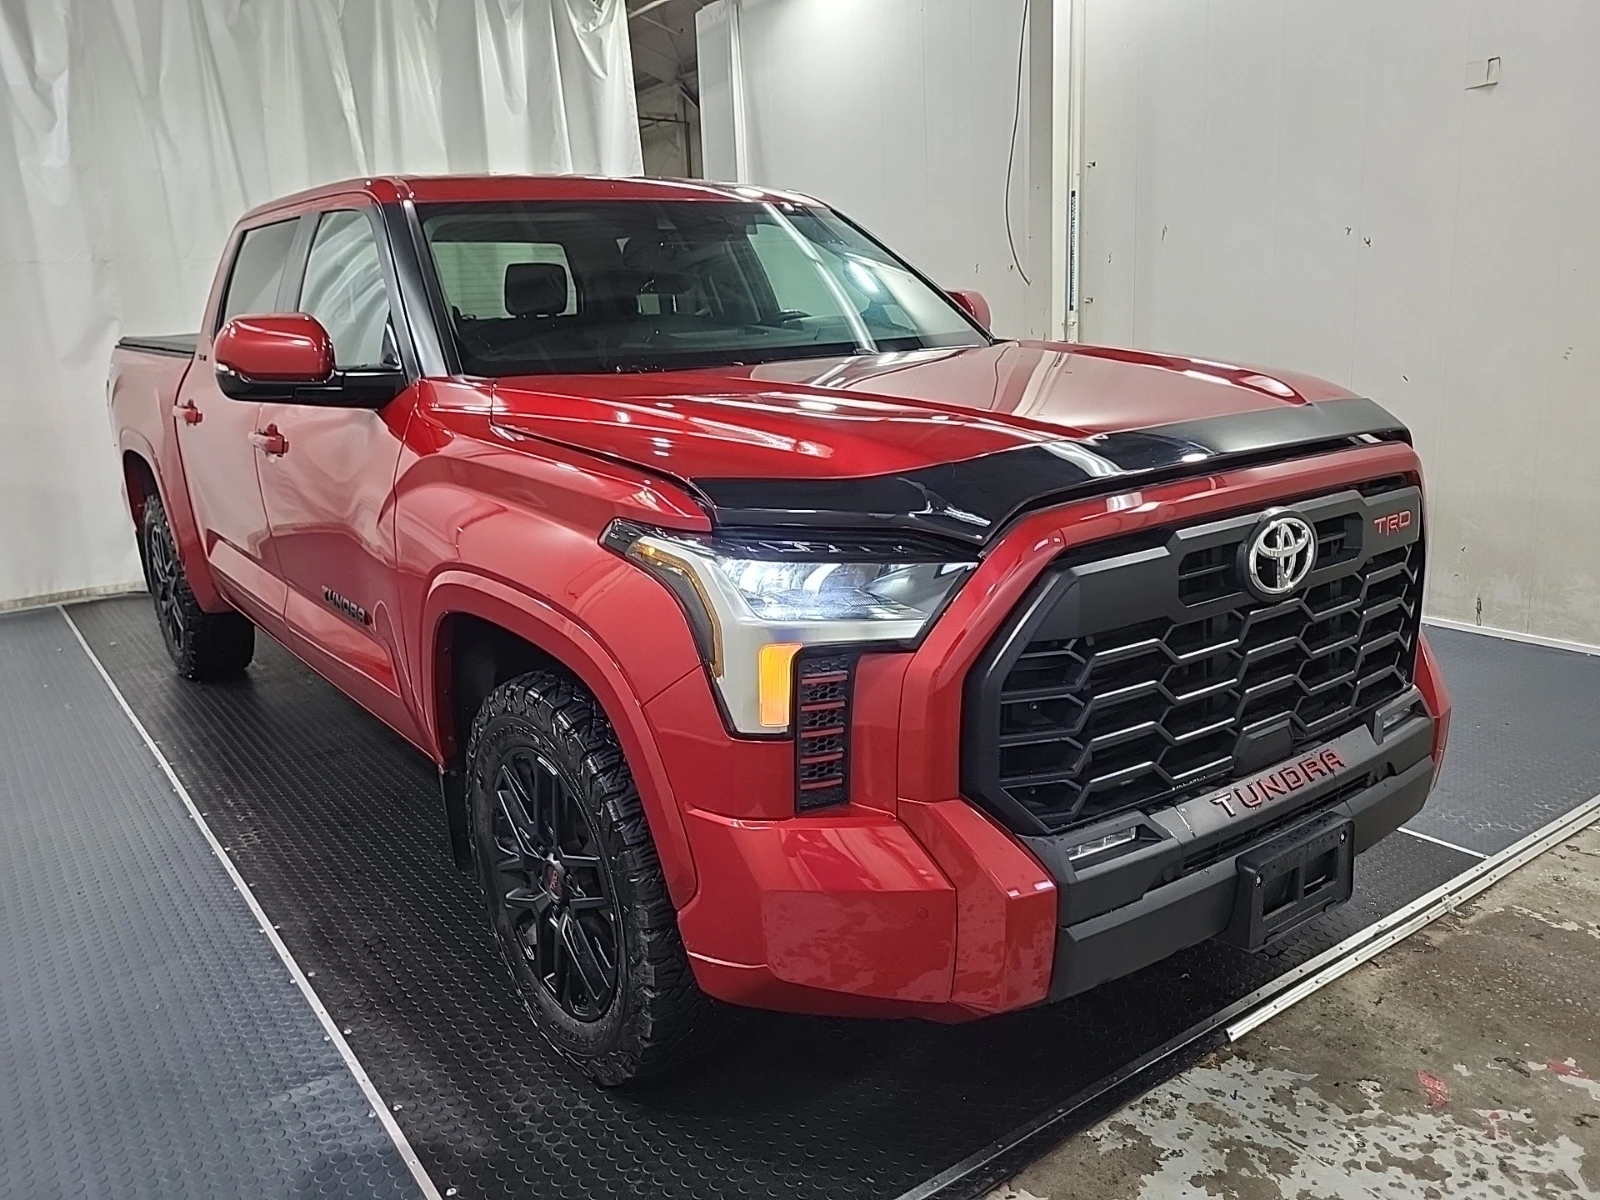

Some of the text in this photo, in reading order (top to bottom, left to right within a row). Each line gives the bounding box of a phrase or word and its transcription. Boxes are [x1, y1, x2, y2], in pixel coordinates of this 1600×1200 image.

[1373, 510, 1411, 537] TRD
[321, 584, 373, 626] TUNDRA
[1209, 748, 1347, 818] TUNDRA
